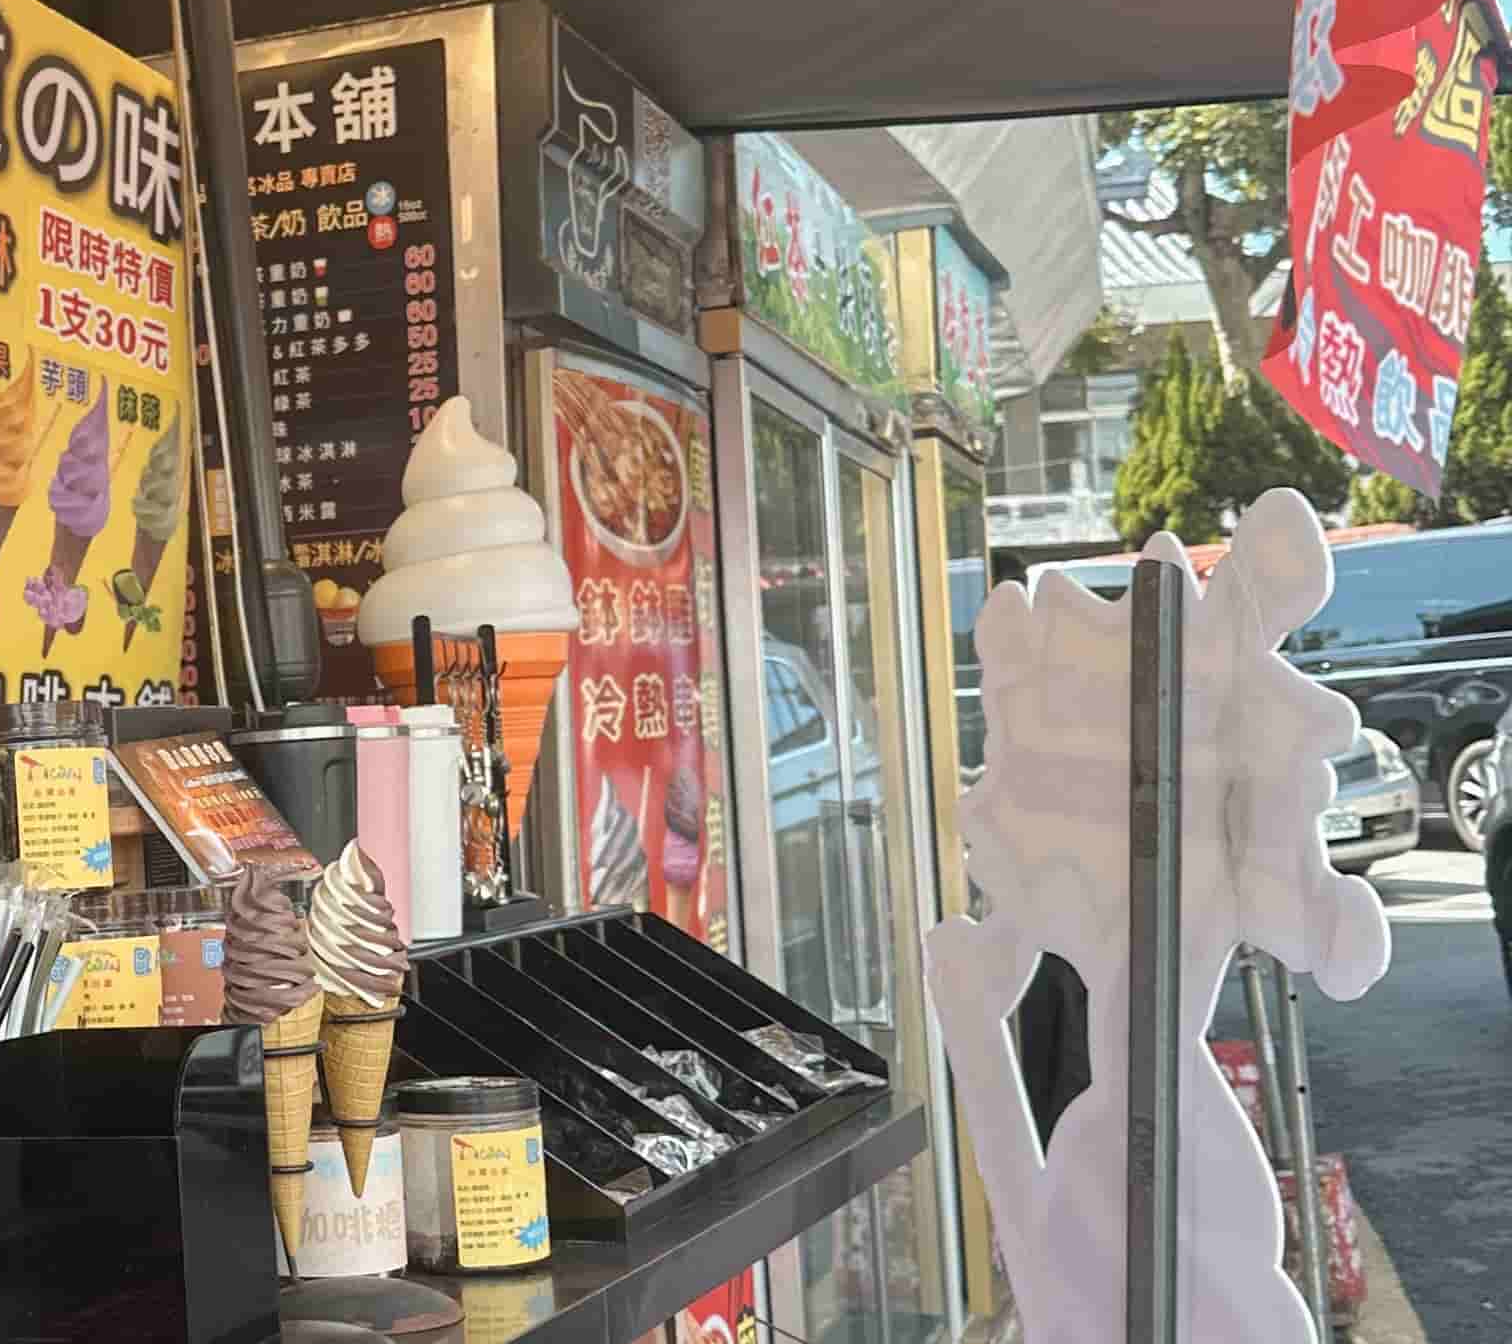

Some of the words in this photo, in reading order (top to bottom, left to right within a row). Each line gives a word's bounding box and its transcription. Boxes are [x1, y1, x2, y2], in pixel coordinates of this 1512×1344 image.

[253, 65, 398, 154] 本舖
[301, 160, 361, 189] 專賣店
[316, 199, 369, 233] 飲品
[39, 205, 178, 312] 限時特價
[36, 286, 173, 375] 1支30元
[39, 357, 90, 406] 芋頭
[408, 350, 439, 376] 25
[408, 376, 440, 402] 25
